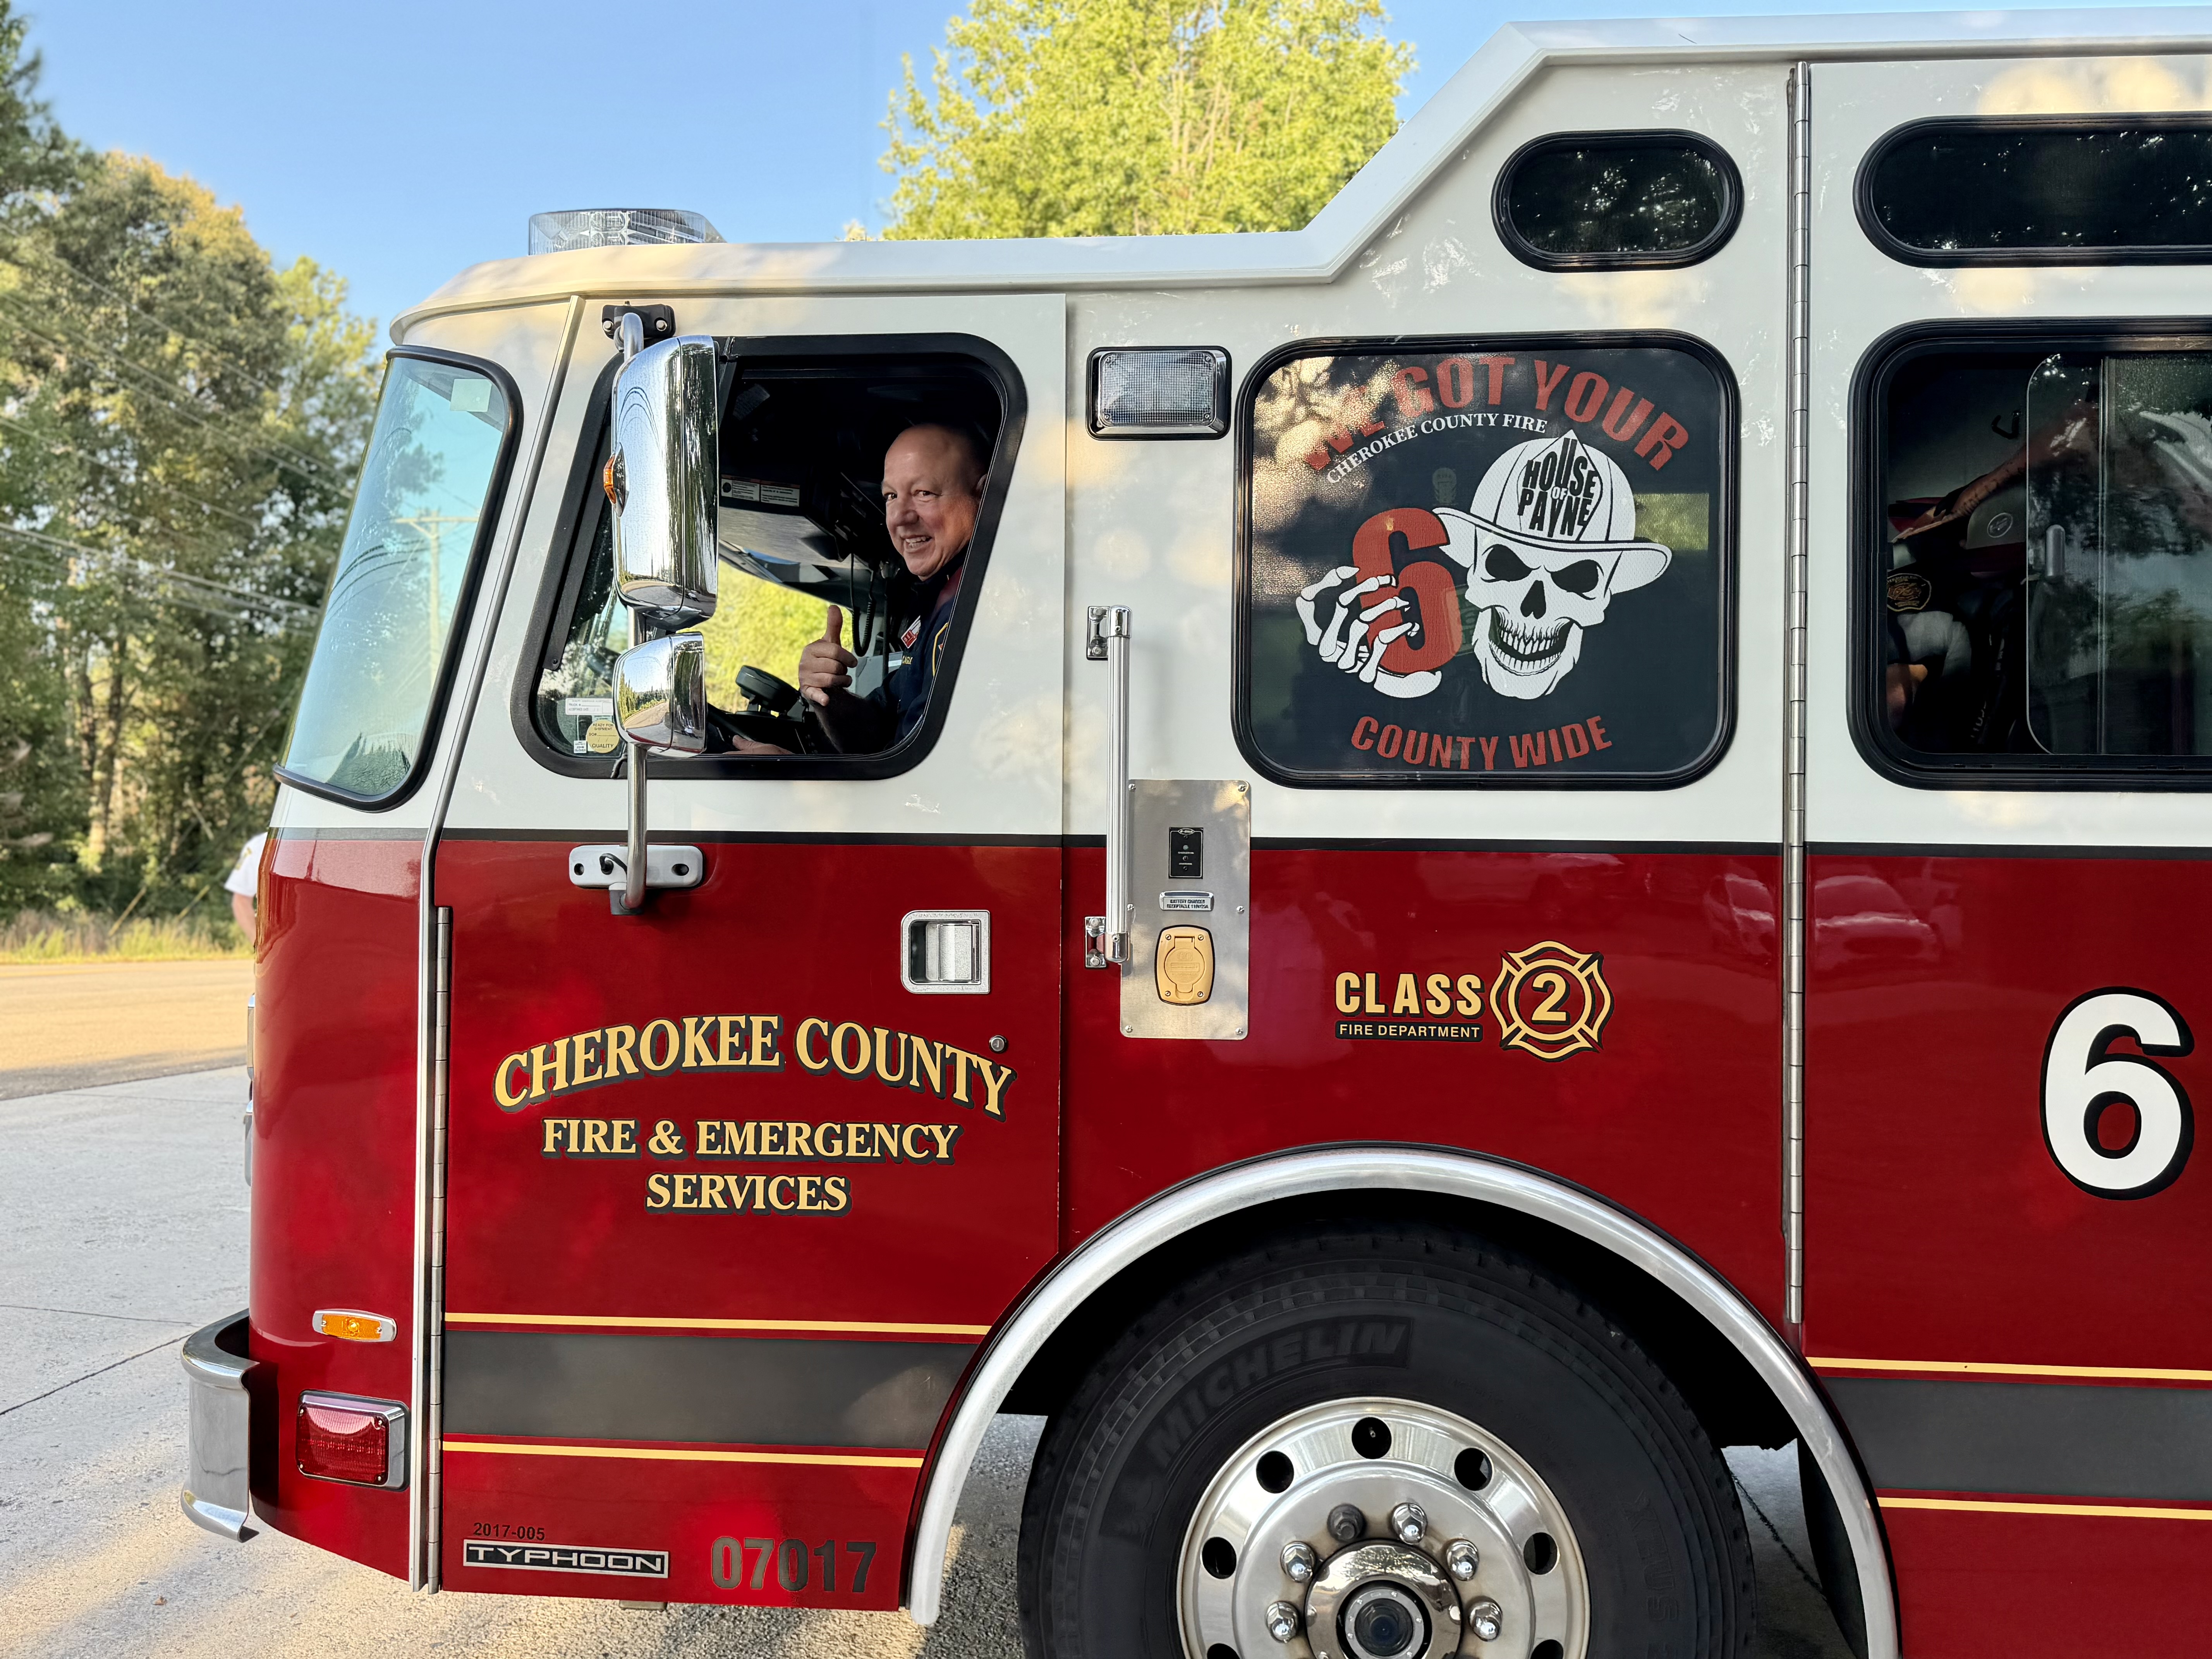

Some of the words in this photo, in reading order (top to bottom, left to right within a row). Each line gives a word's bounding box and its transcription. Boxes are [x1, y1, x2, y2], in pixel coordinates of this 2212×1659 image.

[1391, 357, 1515, 417] GOT
[1534, 360, 1689, 471] YOUR
[1327, 425, 1418, 483] CHEROKEE
[1420, 413, 1499, 434] COUNTY
[1503, 414, 1548, 433] FIRE
[1522, 437, 1599, 499] HOUSE
[1517, 488, 1593, 538] PAYNE
[1551, 486, 1568, 500] OF
[1352, 507, 1462, 674] 6
[1351, 716, 1499, 771] COUNTY
[1509, 715, 1612, 769] WIDE
[1336, 972, 1481, 1015] CLASS
[1531, 972, 1567, 1021] 2
[1340, 1024, 1373, 1036] FIRE
[1378, 1025, 1480, 1038] DEPARTMENT
[495, 1015, 781, 1108] CHEROKEE
[795, 1017, 1012, 1116] COUNTY
[2045, 993, 2183, 1191] 6
[543, 1119, 637, 1154] FIRE
[648, 1120, 684, 1154] &
[696, 1121, 959, 1159] EMERGENCY
[646, 1174, 847, 1211] SERVICES
[1146, 1321, 1407, 1470] MICHELIN
[468, 1546, 661, 1571] TYPHOON
[473, 1522, 545, 1540] 2017-005
[711, 1536, 877, 1593] 07017
